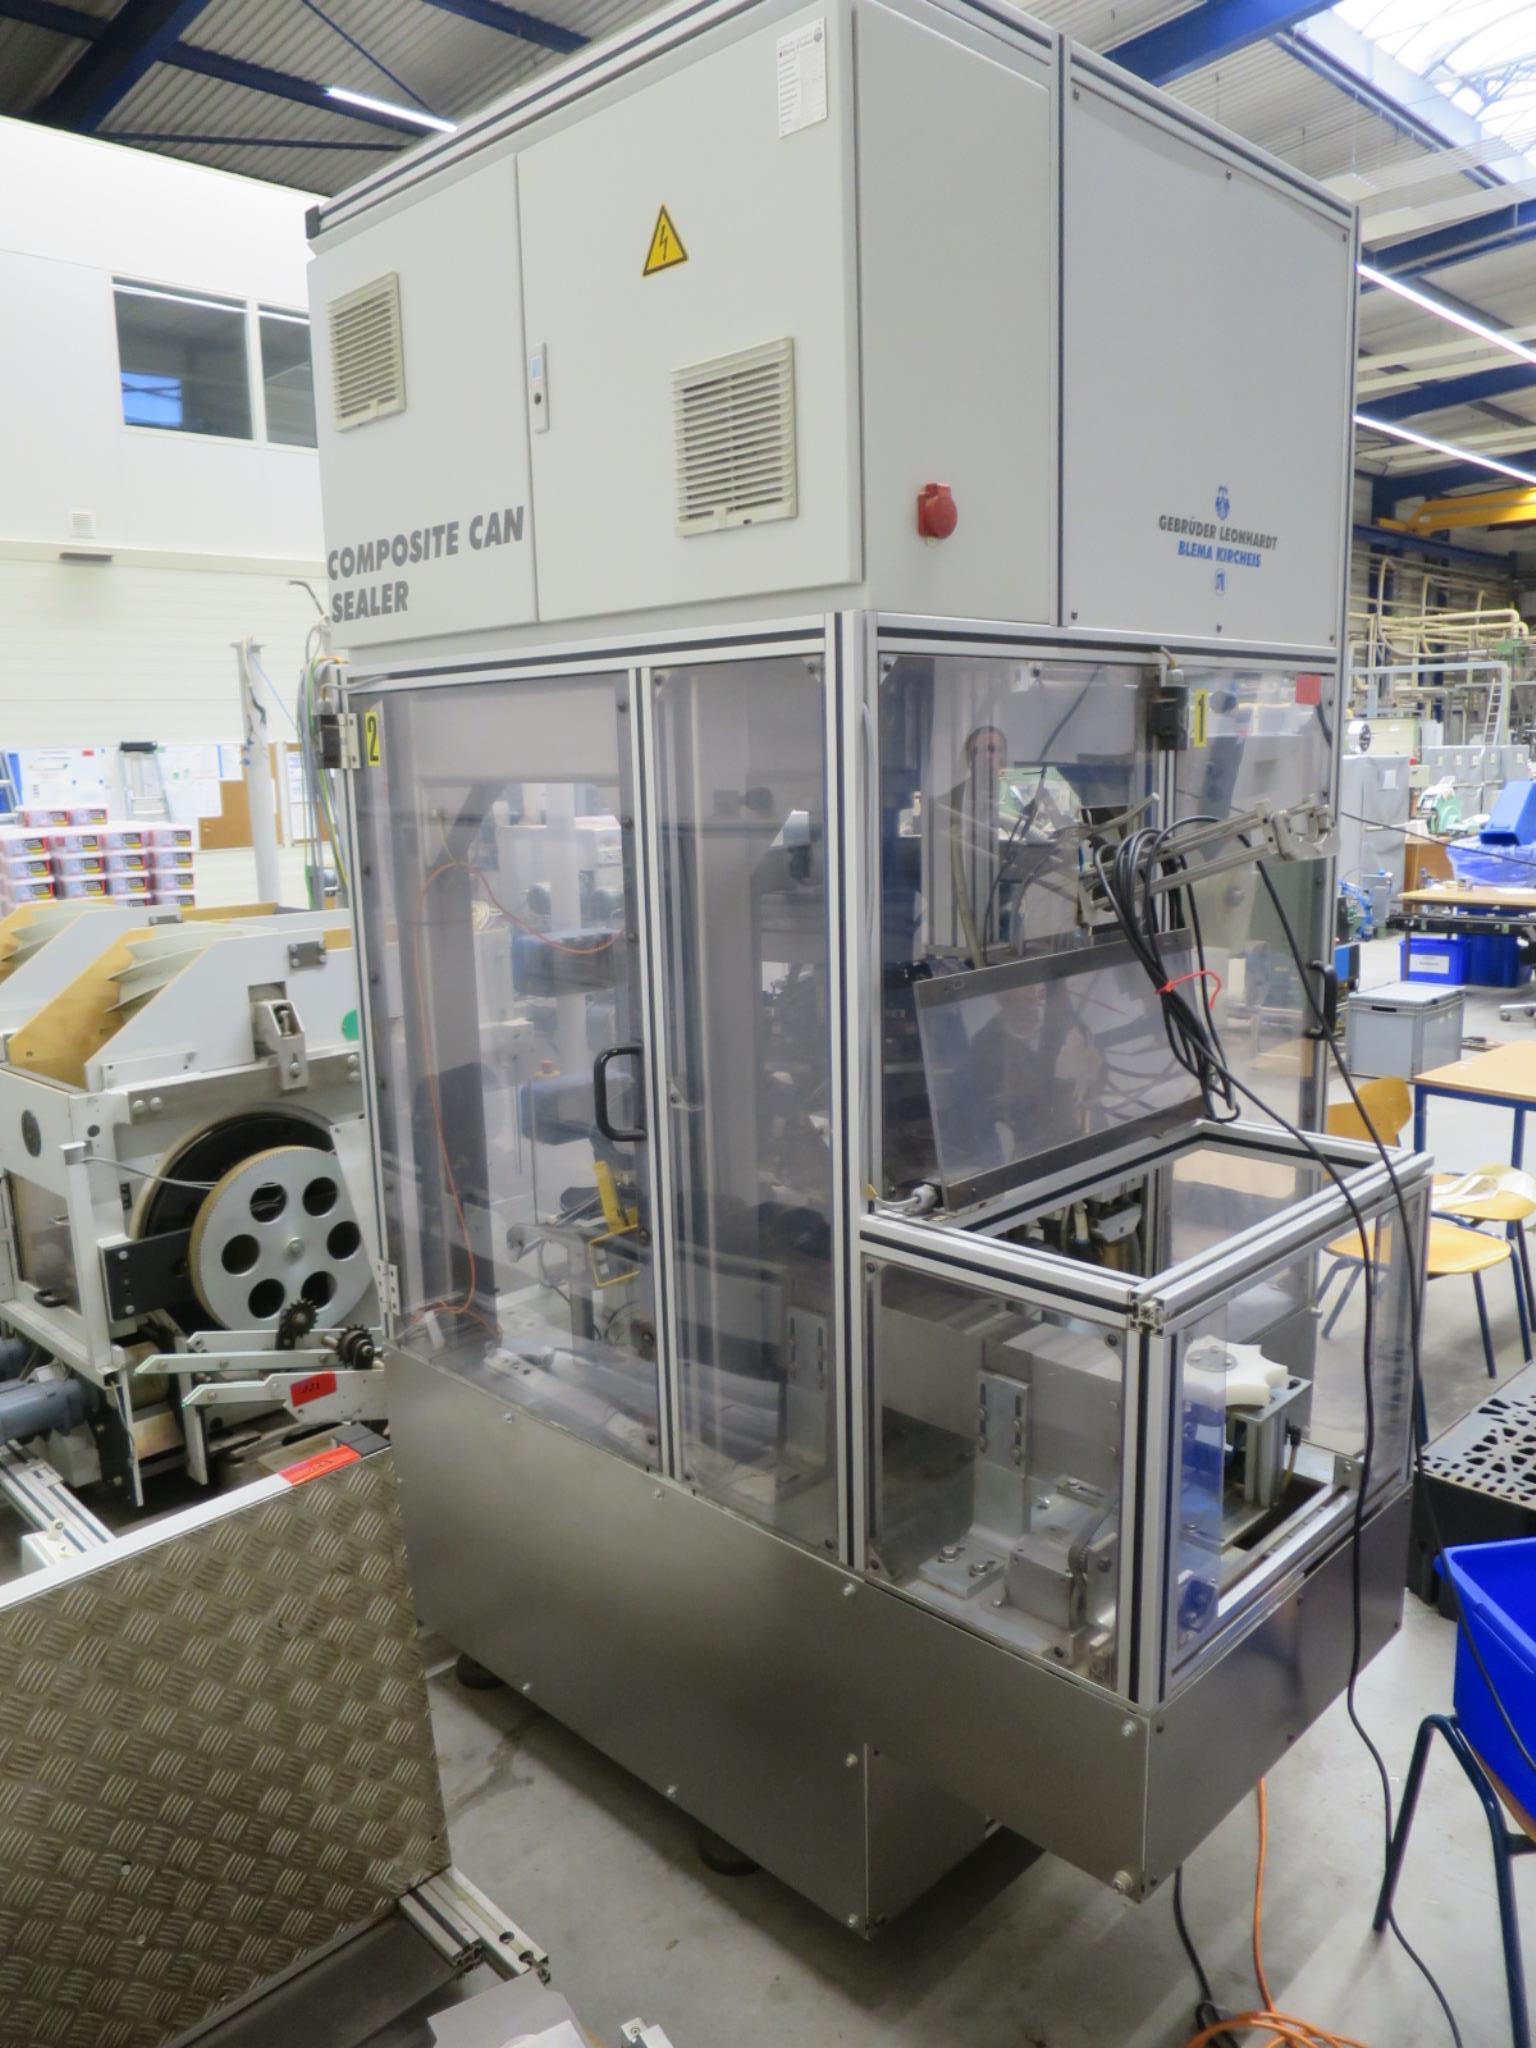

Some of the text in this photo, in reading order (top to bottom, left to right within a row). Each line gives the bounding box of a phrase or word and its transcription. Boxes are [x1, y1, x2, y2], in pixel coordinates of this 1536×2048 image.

[328, 506, 524, 580] COMPOSITE CAN
[1159, 514, 1278, 550] GEBRÜDER LEONHARDT
[332, 581, 409, 623] SEALER
[367, 715, 379, 762] 2
